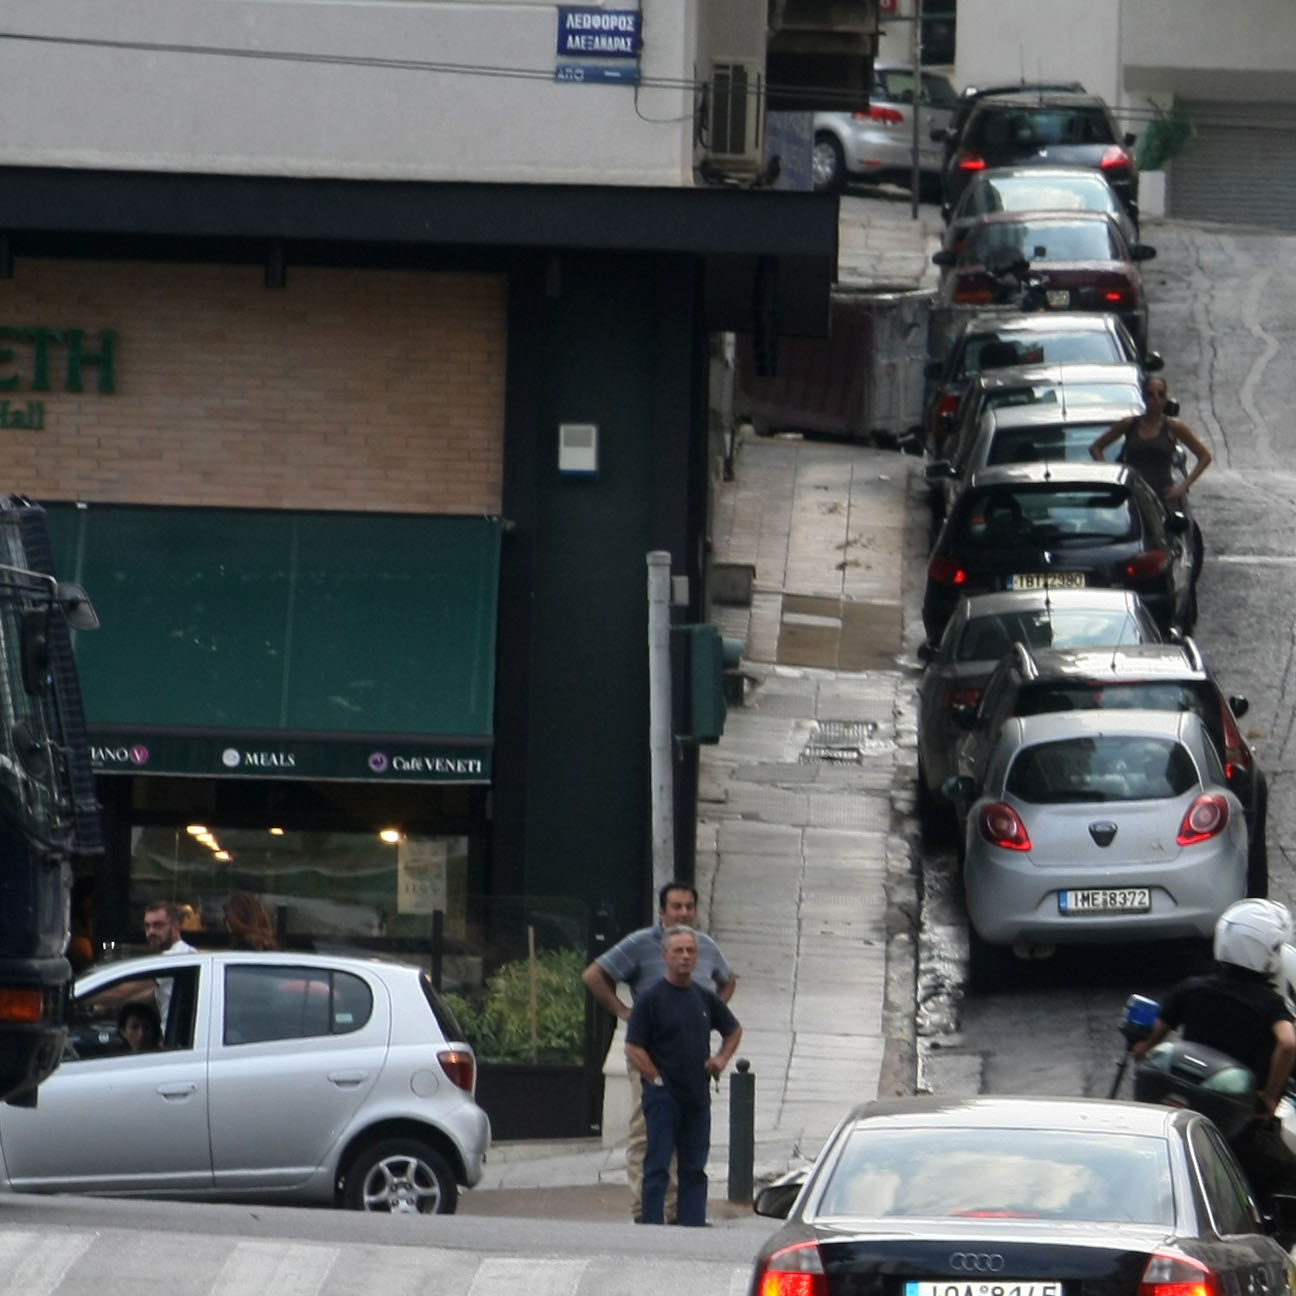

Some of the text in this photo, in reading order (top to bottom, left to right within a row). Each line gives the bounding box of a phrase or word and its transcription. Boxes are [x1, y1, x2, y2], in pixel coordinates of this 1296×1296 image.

[566, 13, 635, 31] ΛΕΩΦΟΡΟΣ
[566, 34, 632, 52] ΑΛΕΞΑΝΔΡΑΣ
[244, 753, 296, 767] MEALS
[424, 757, 482, 773] VENETI
